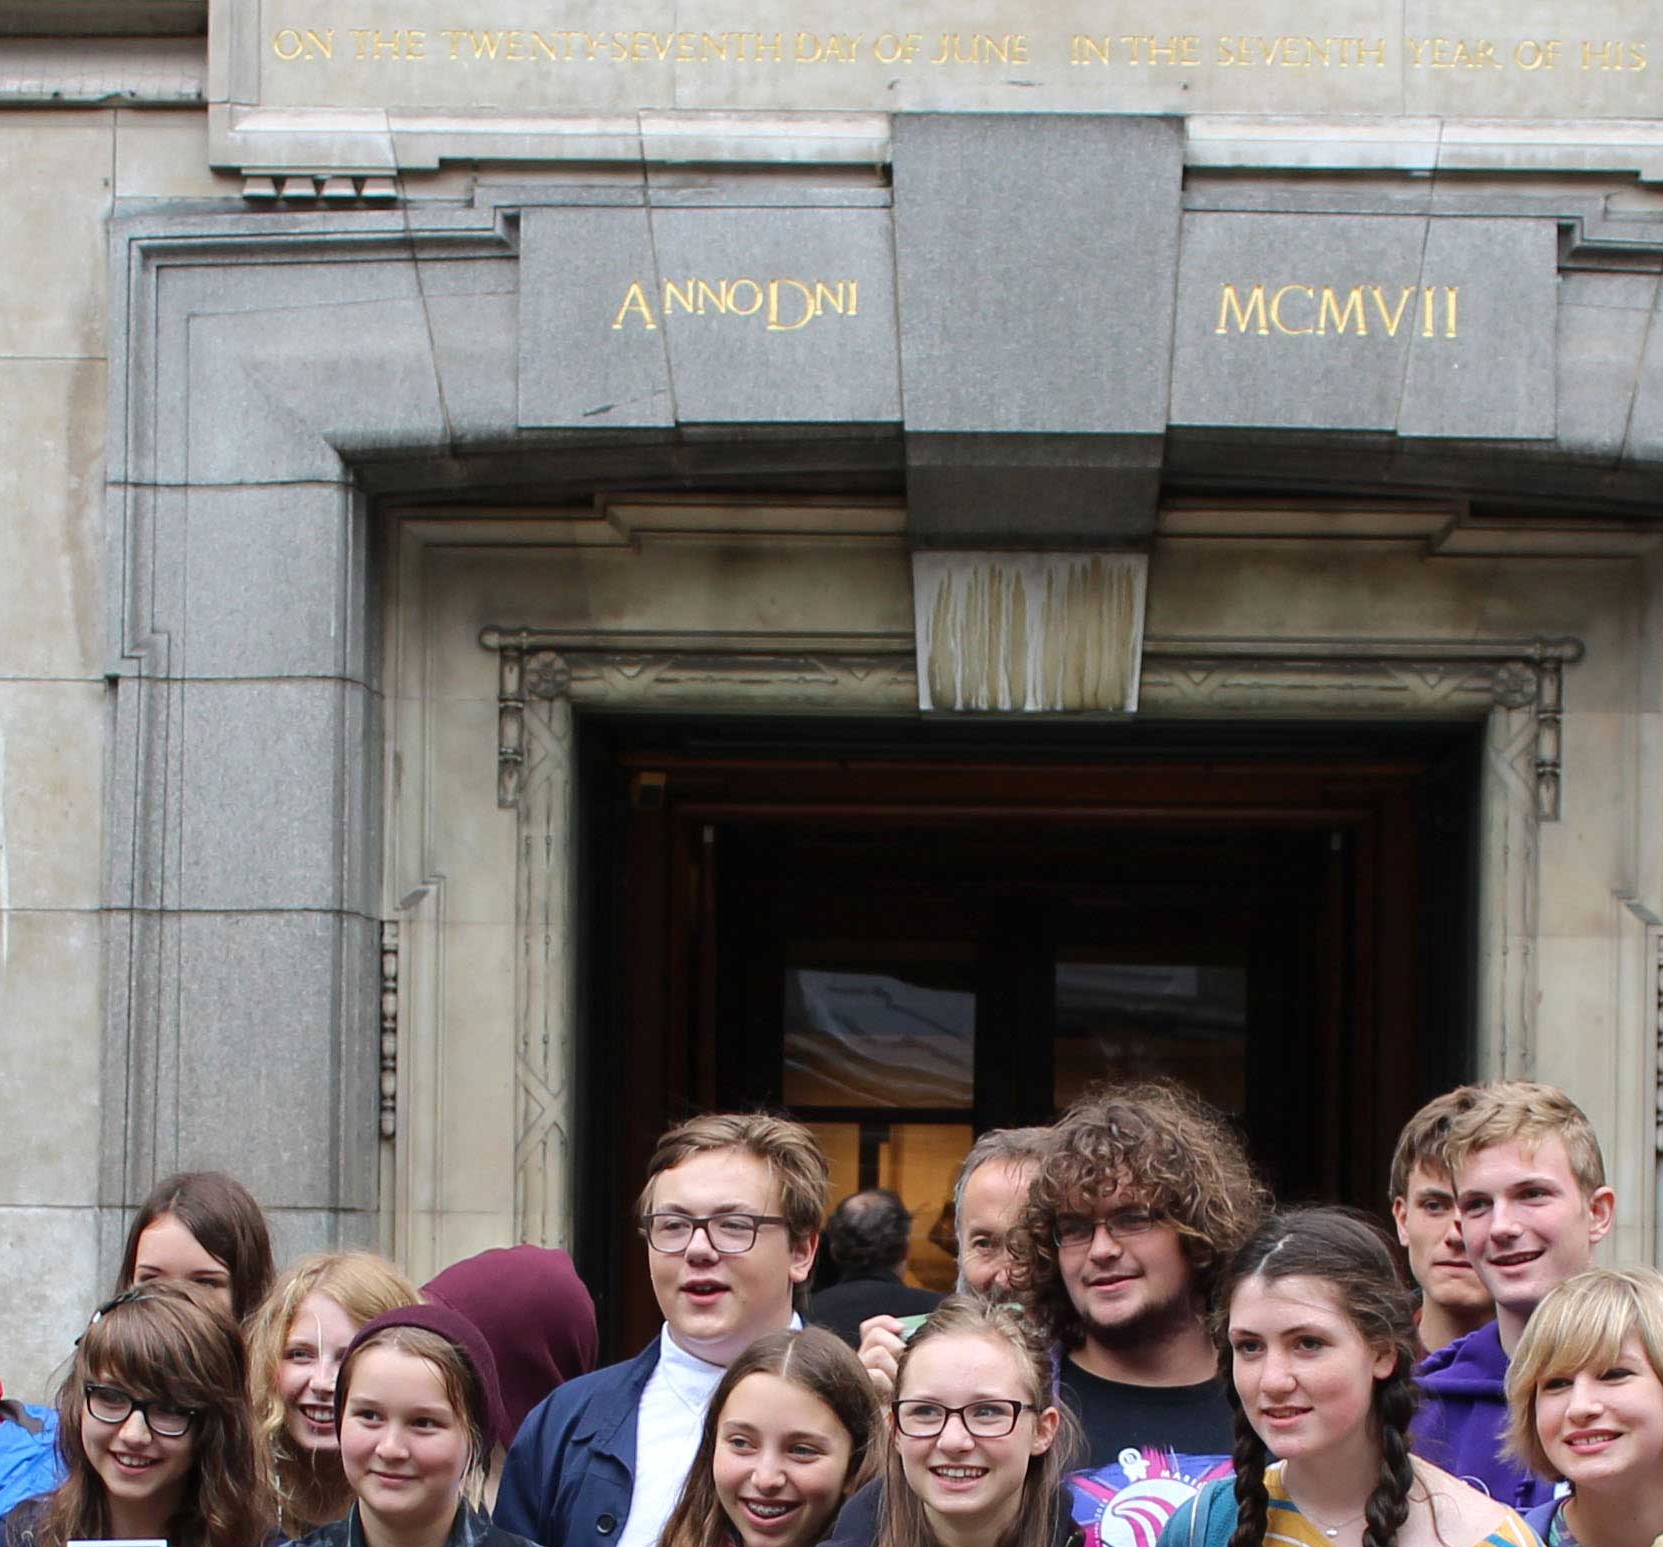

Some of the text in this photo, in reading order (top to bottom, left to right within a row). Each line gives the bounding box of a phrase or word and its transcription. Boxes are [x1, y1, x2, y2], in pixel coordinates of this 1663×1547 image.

[272, 28, 336, 62] ON
[348, 28, 428, 62] THE
[440, 29, 783, 64] TWENTY-SEVENTH
[793, 31, 864, 64] DAY
[872, 32, 923, 65] OF
[932, 32, 1031, 66] JUNE
[1069, 35, 1111, 67] IN
[1120, 35, 1199, 67] THE
[1217, 35, 1386, 68] SEVENTH
[1407, 37, 1503, 70] YEAR
[1514, 38, 1563, 71] OF
[1580, 39, 1647, 72] HIS
[1214, 283, 1460, 339] MCMVII
